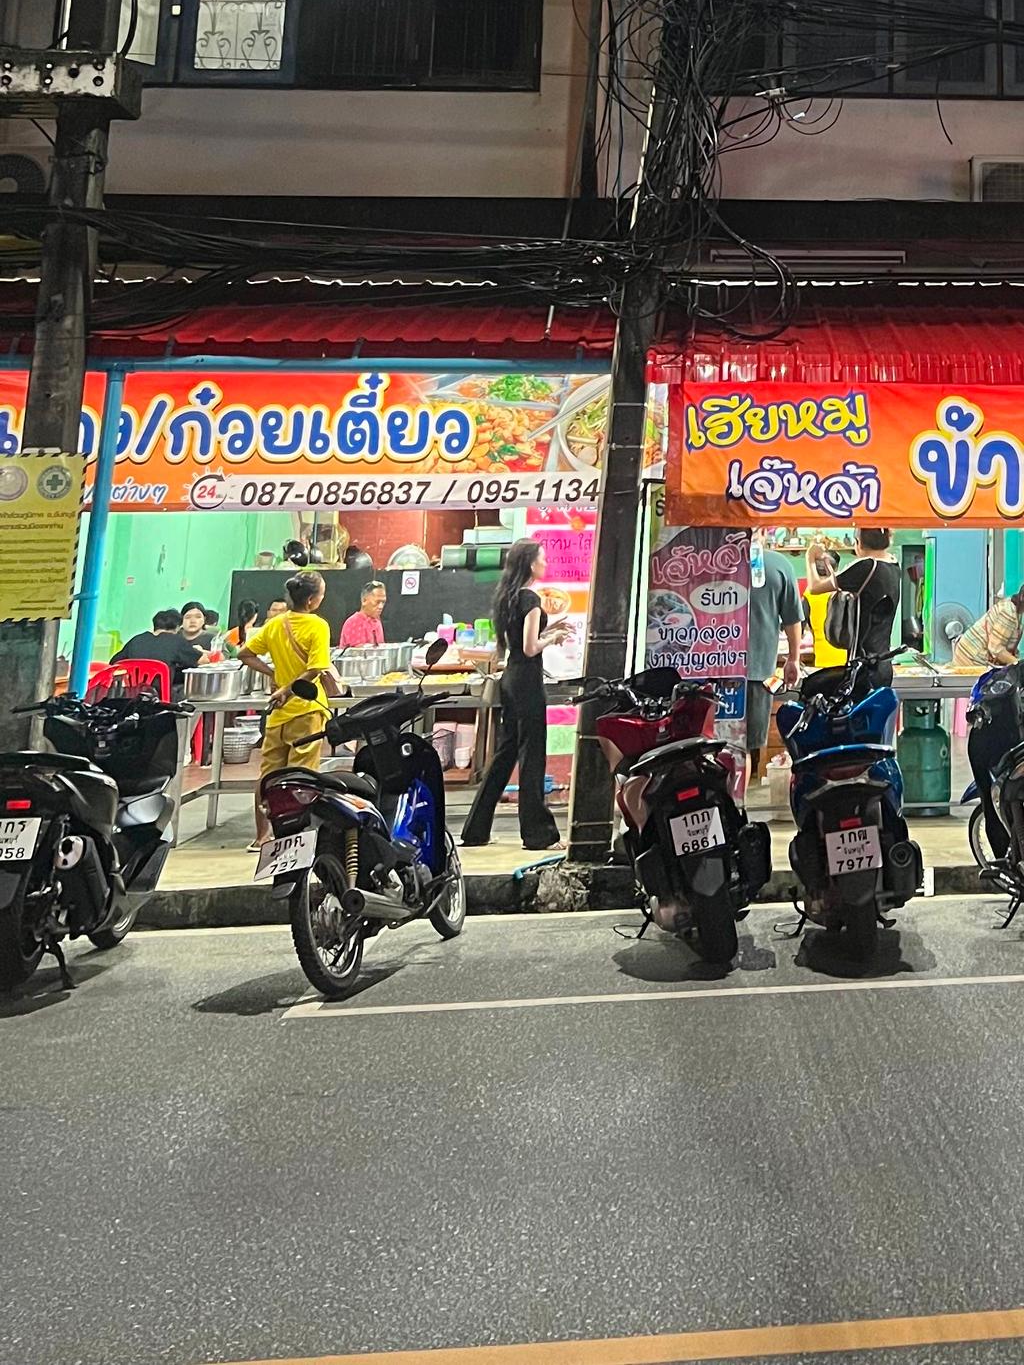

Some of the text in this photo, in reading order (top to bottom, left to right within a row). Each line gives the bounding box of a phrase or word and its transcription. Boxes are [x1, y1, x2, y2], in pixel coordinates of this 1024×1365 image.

[687, 393, 868, 446] เฮียหมู
[197, 485, 216, 499] 24
[241, 480, 431, 506] 087-0856837
[700, 587, 739, 607] รับทำ
[0, 820, 27, 833] กร
[682, 834, 718, 853] 6861
[836, 855, 874, 873] 7977
